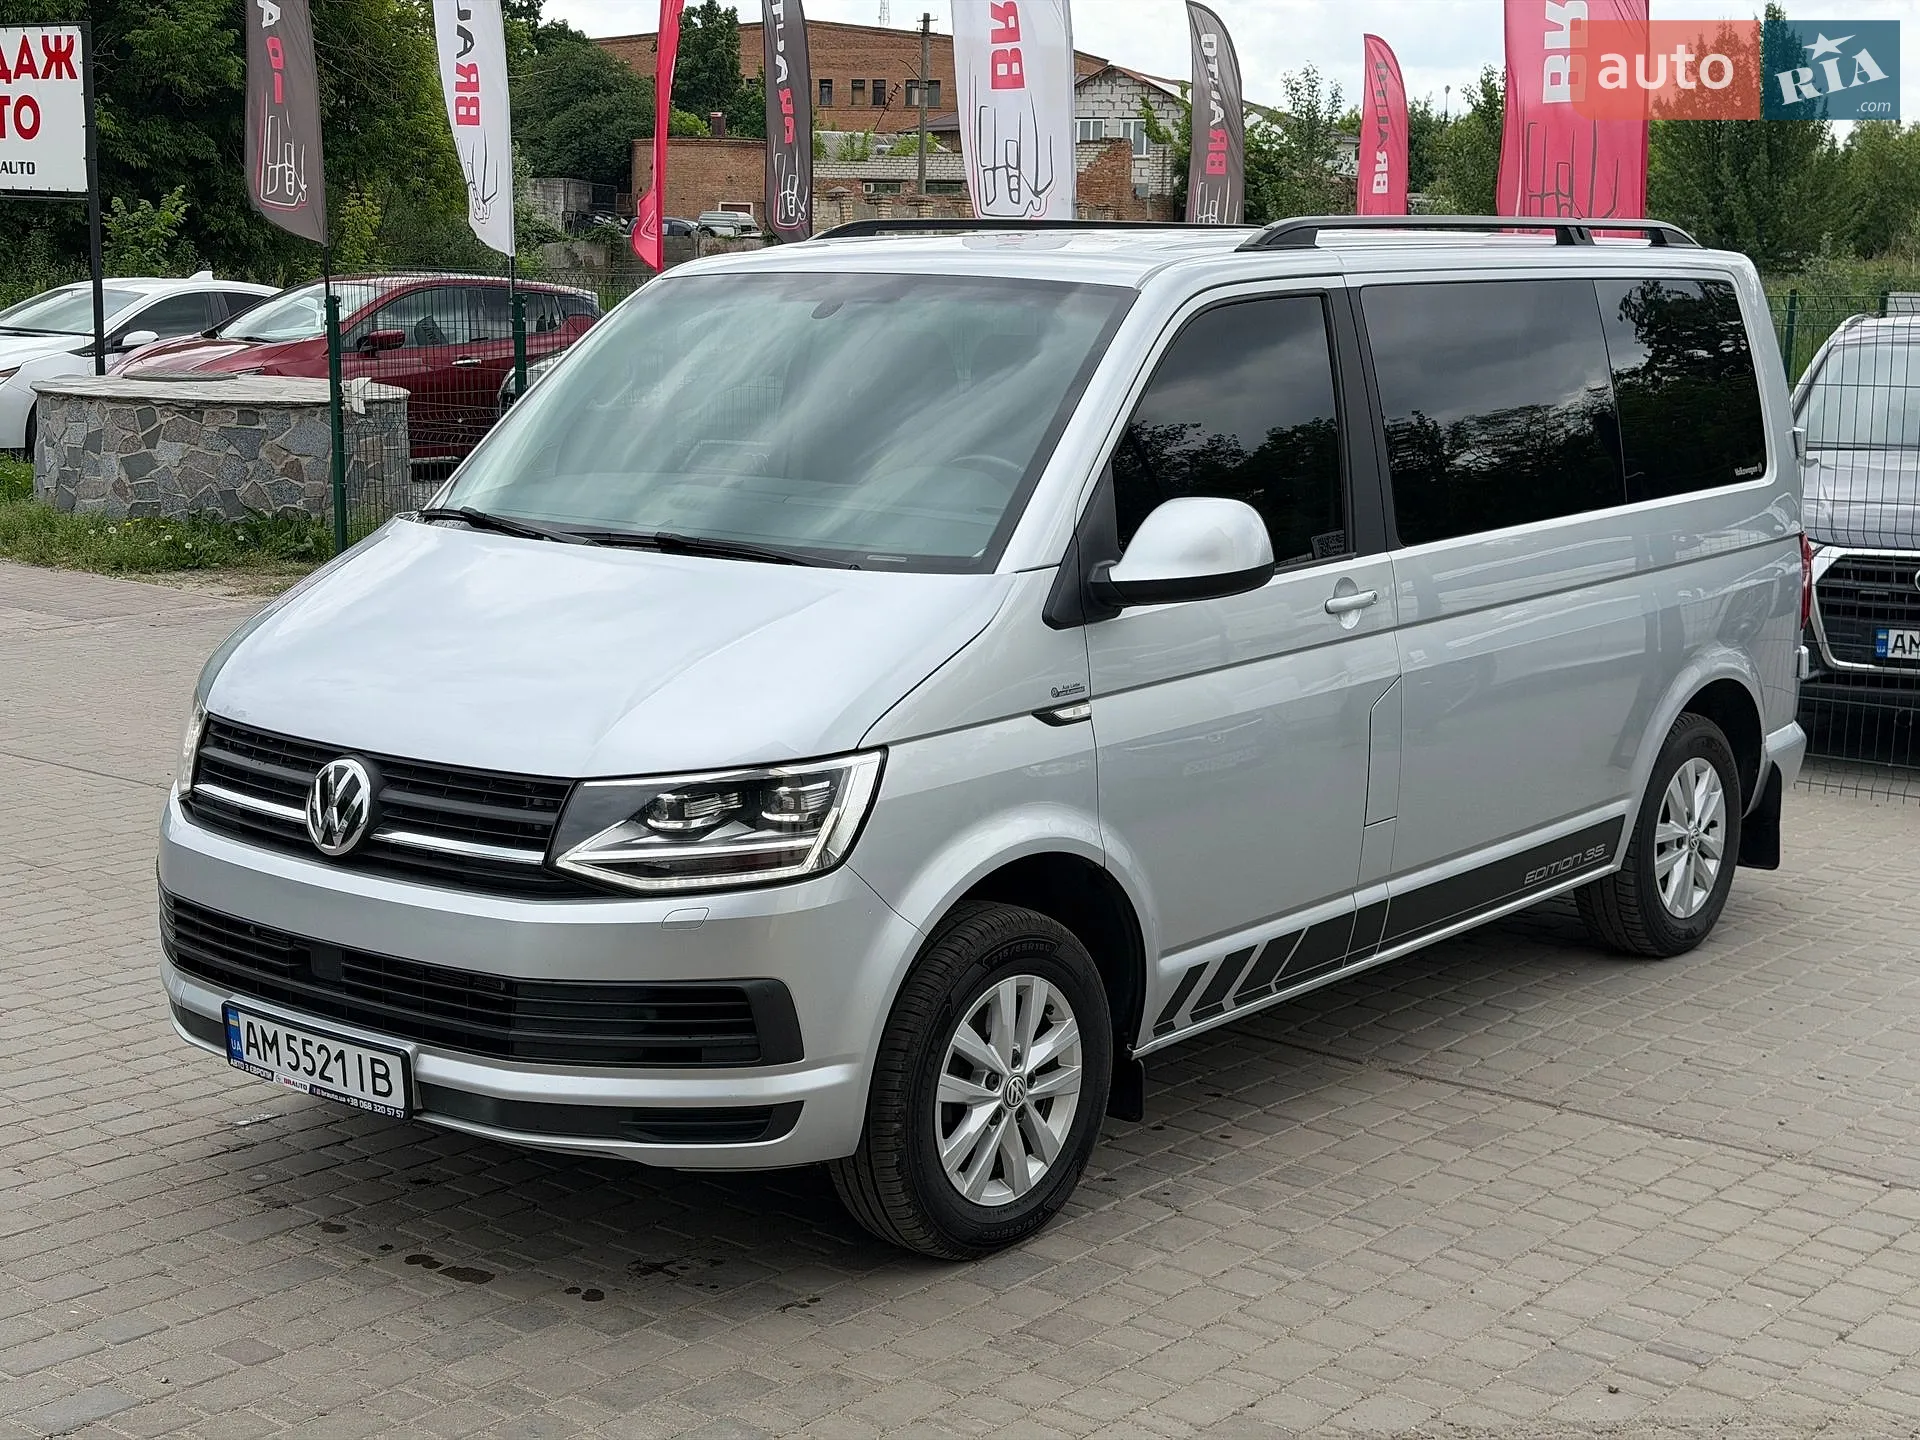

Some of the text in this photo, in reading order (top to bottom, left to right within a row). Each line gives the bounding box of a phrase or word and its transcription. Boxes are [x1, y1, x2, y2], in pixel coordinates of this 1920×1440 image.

[230, 1039, 242, 1052] UA
[245, 1021, 393, 1098] AM 5521 IB
[359, 1100, 373, 1111] 068
[373, 1103, 386, 1114] 320
[386, 1107, 395, 1117] 57
[395, 1109, 405, 1119] 57
